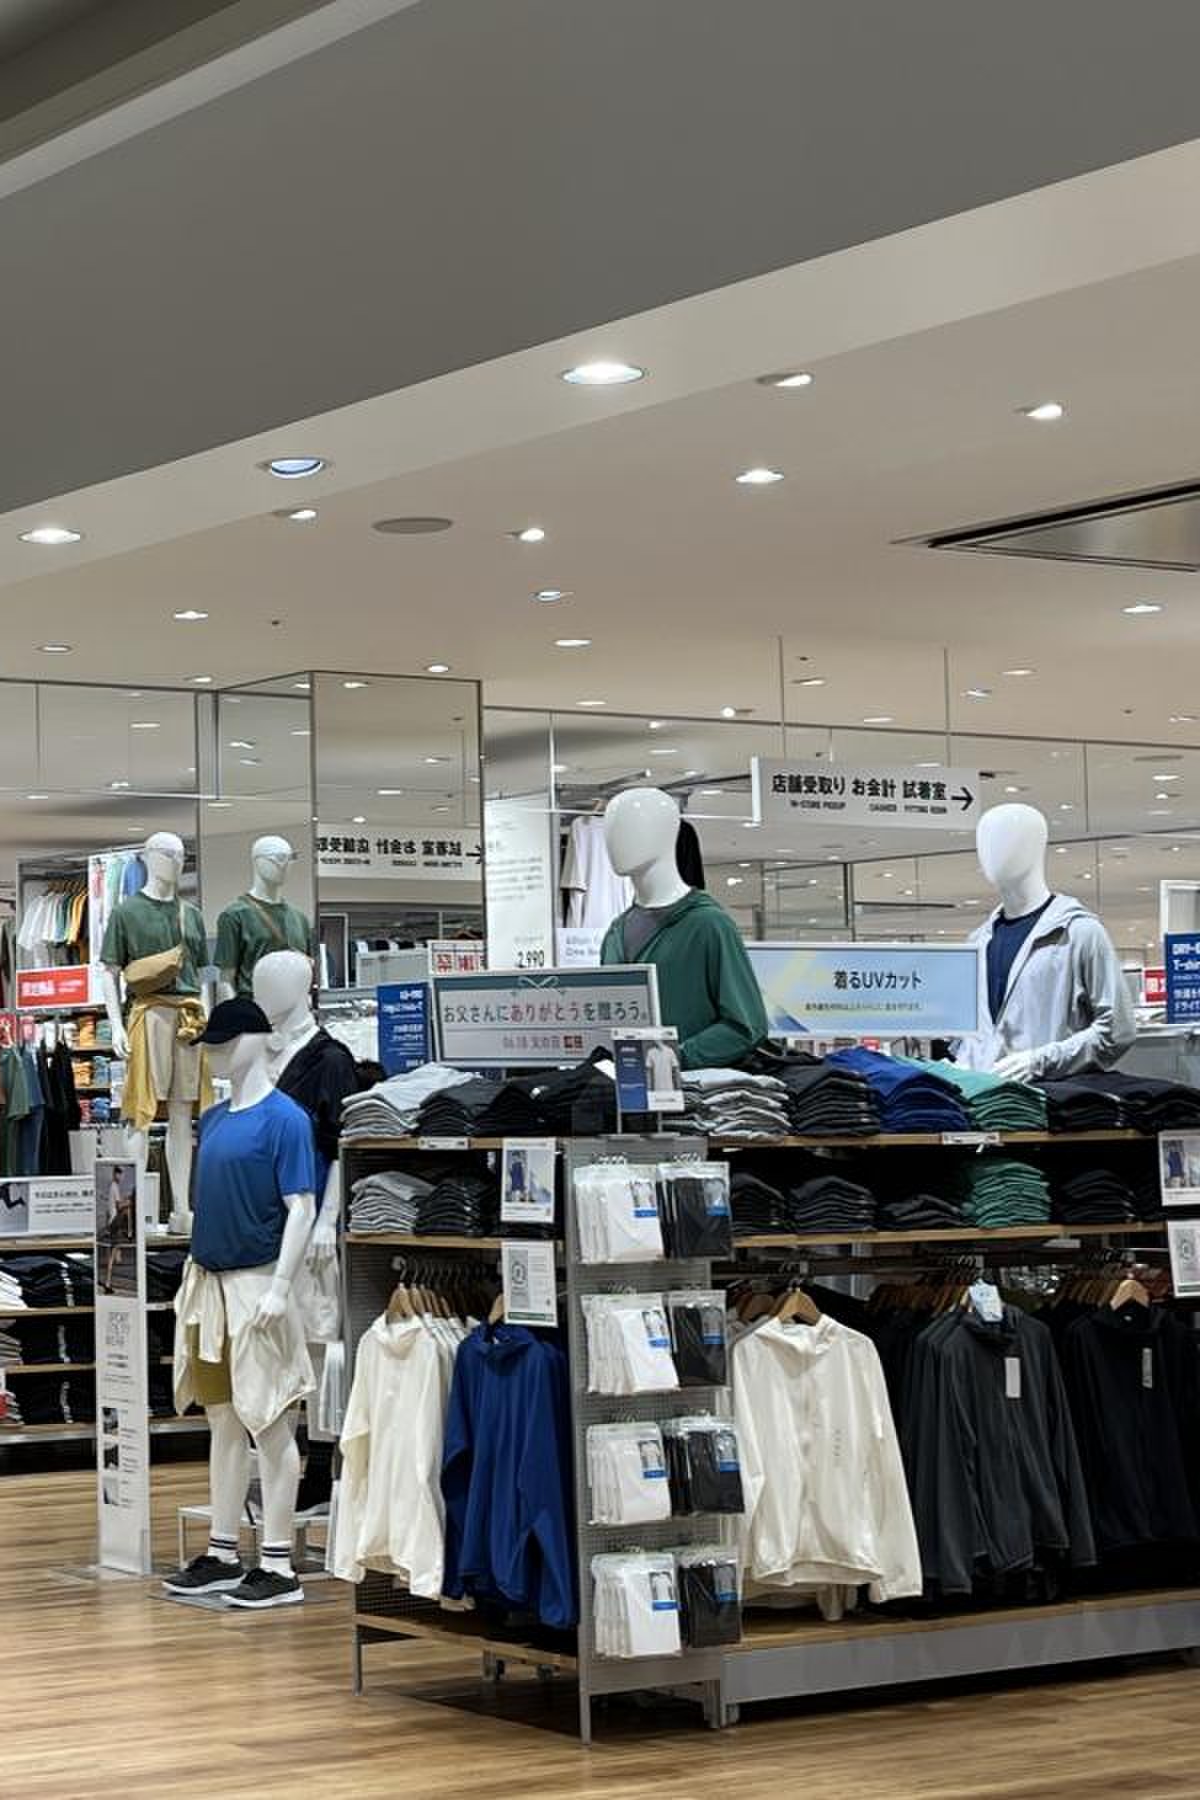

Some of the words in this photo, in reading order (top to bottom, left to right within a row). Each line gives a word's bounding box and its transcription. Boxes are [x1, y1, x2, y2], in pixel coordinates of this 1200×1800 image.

[834, 970, 922, 990] 着るUVカット
